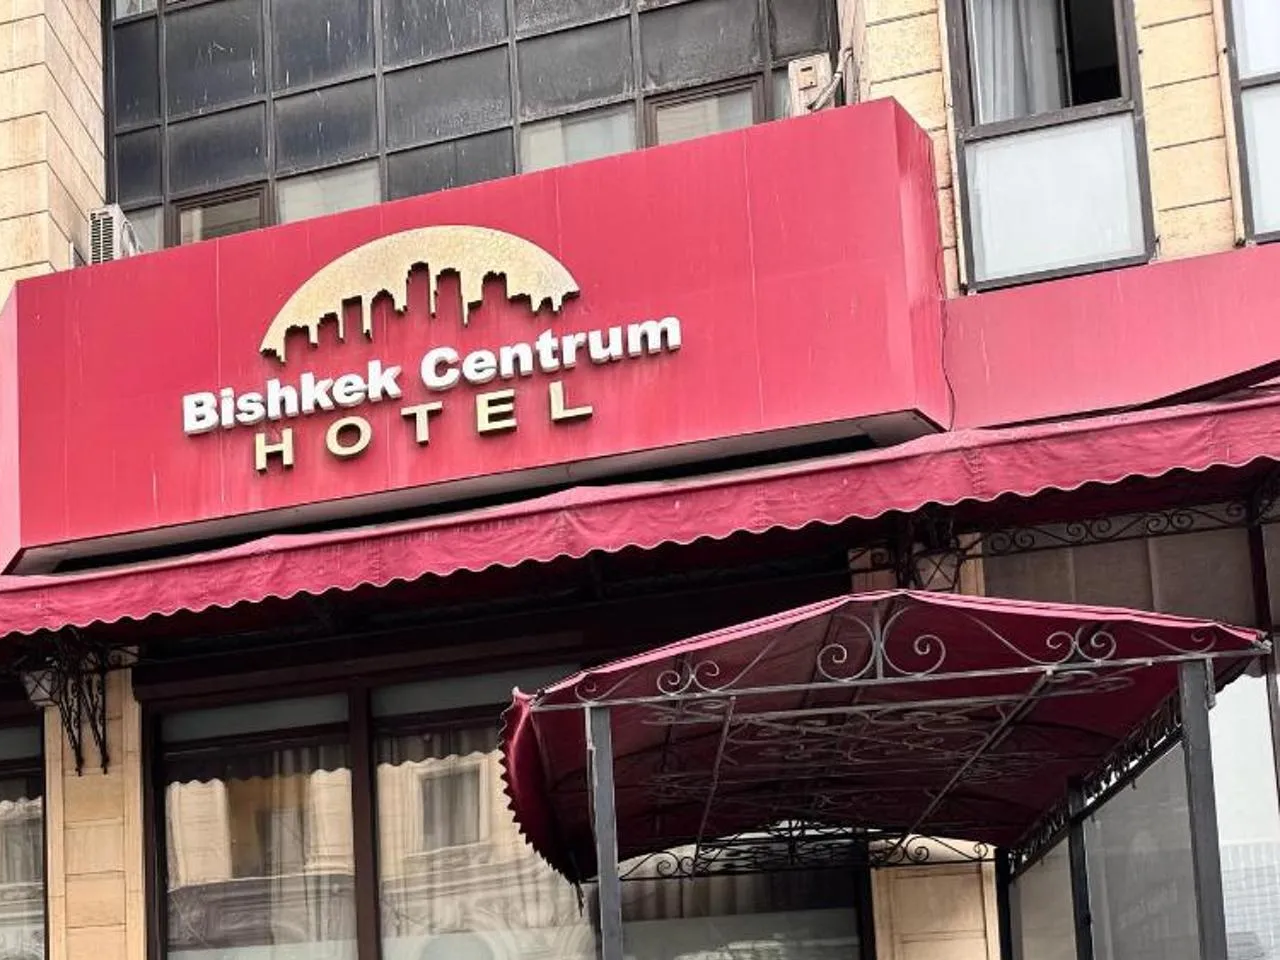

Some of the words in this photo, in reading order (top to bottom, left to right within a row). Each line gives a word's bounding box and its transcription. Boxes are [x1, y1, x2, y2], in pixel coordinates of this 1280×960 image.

[182, 359, 402, 436] Bishkek
[421, 315, 682, 391] Centrum
[255, 381, 594, 472] HOTEL
